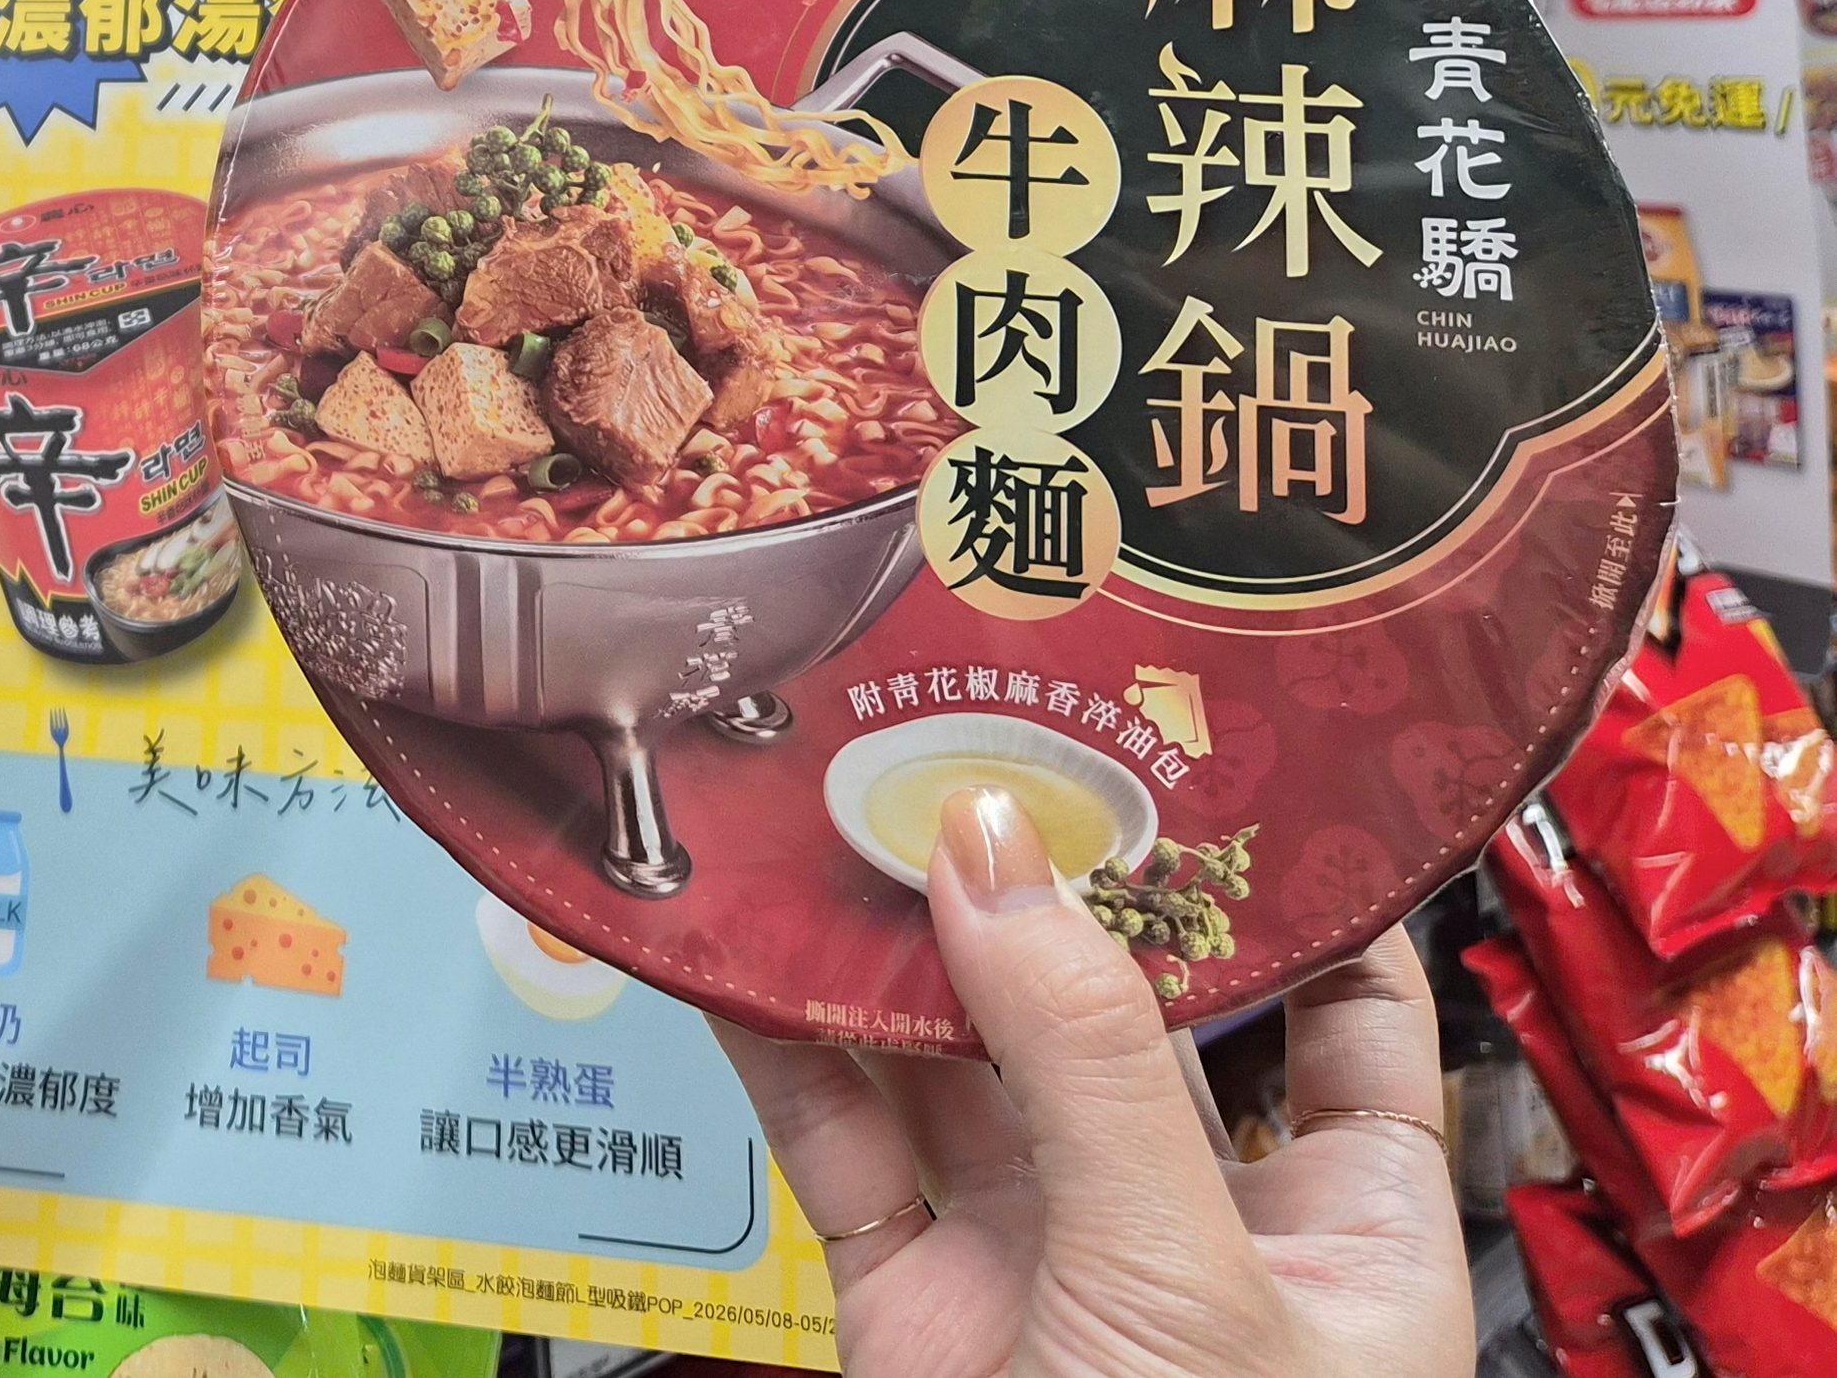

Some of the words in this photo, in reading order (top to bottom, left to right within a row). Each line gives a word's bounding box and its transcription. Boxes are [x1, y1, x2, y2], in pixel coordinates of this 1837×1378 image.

[85, 247, 181, 285] 라면
[43, 291, 88, 312] SHIN
[89, 282, 128, 301] CUP
[1416, 308, 1473, 328] CHIN
[947, 99, 1091, 600] 牛肉麵
[1416, 330, 1519, 353] HUAJIAO
[139, 420, 208, 483] 라면
[139, 482, 179, 515] SHIN
[176, 456, 210, 494] CUP
[1587, 511, 1641, 614] 掀開至此
[228, 1026, 315, 1077] 起司
[485, 1052, 617, 1111] 半熟蛋
[182, 1081, 355, 1148] 增加香氣
[419, 1106, 685, 1183] 讓口感更滑順
[3, 1336, 96, 1371] Flavor
